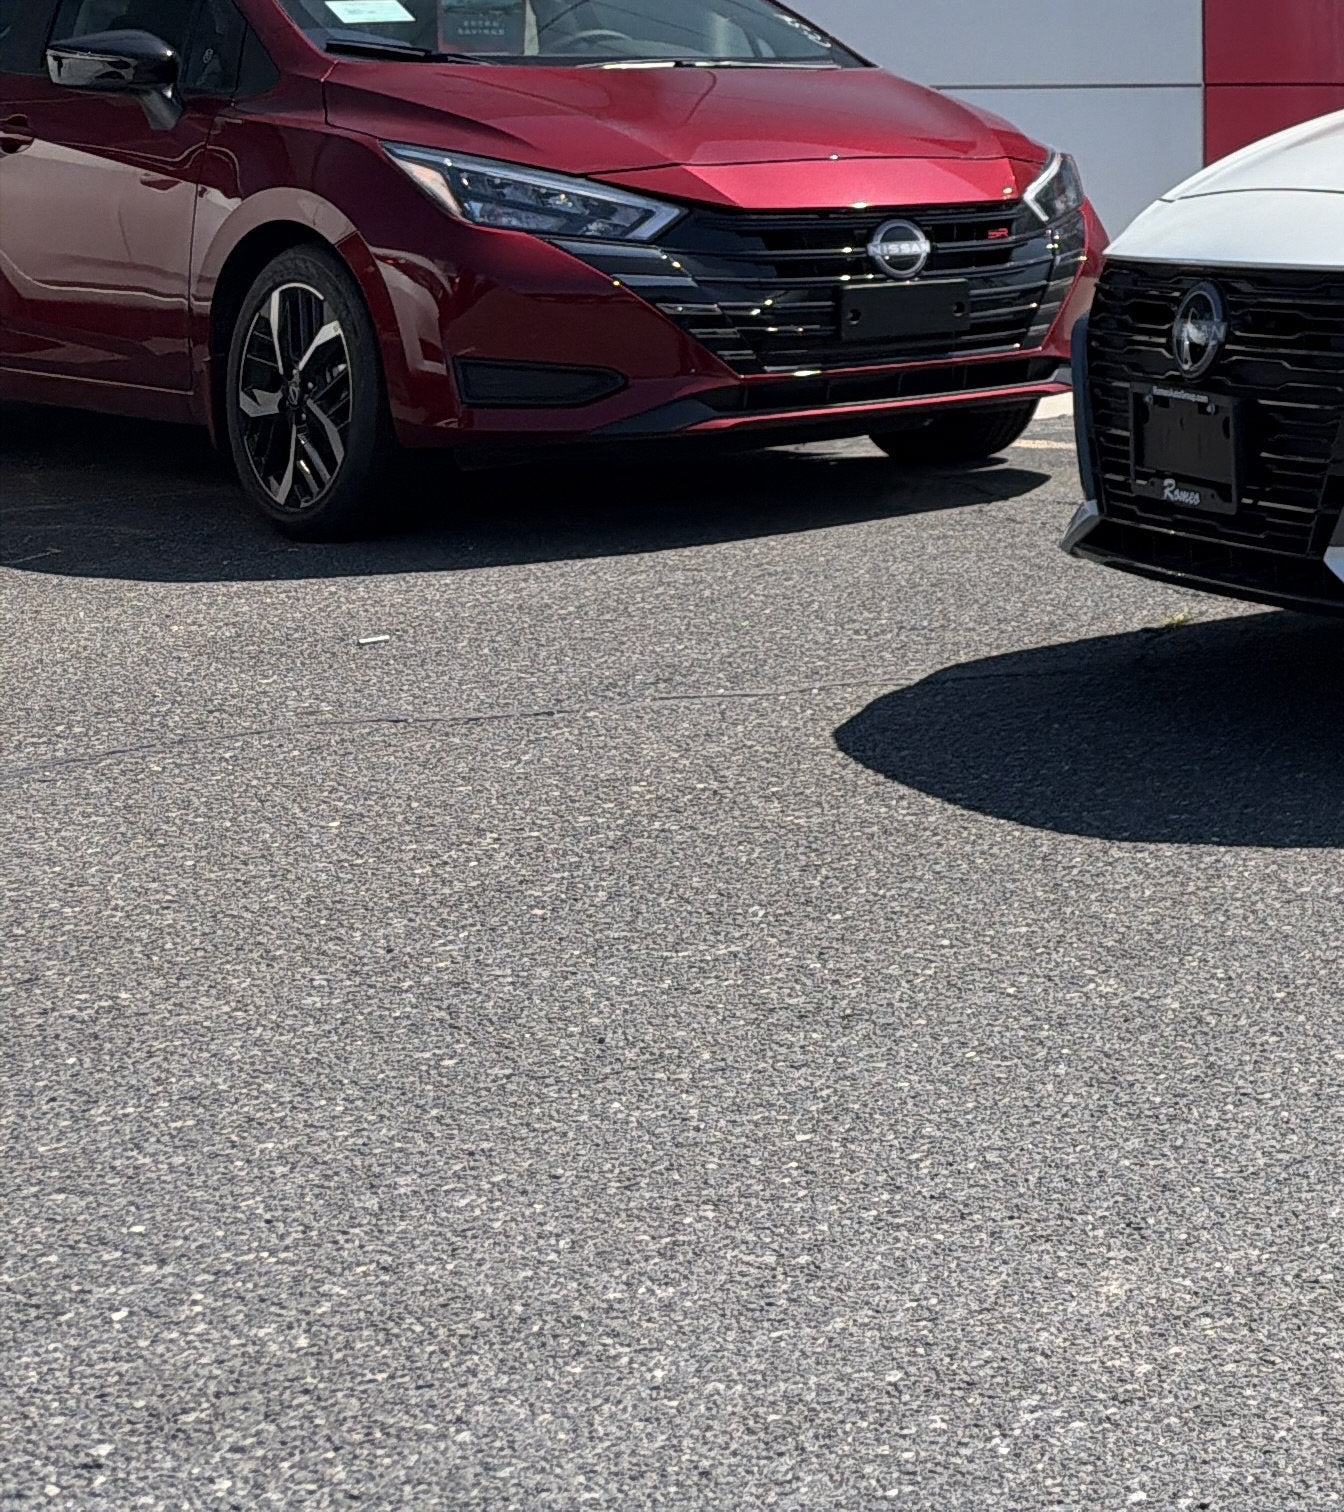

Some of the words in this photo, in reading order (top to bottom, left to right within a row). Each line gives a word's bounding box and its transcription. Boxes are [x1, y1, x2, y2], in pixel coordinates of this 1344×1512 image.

[988, 228, 1008, 239] SR
[869, 242, 929, 255] NISSAN
[1163, 478, 1201, 505] Romeo
